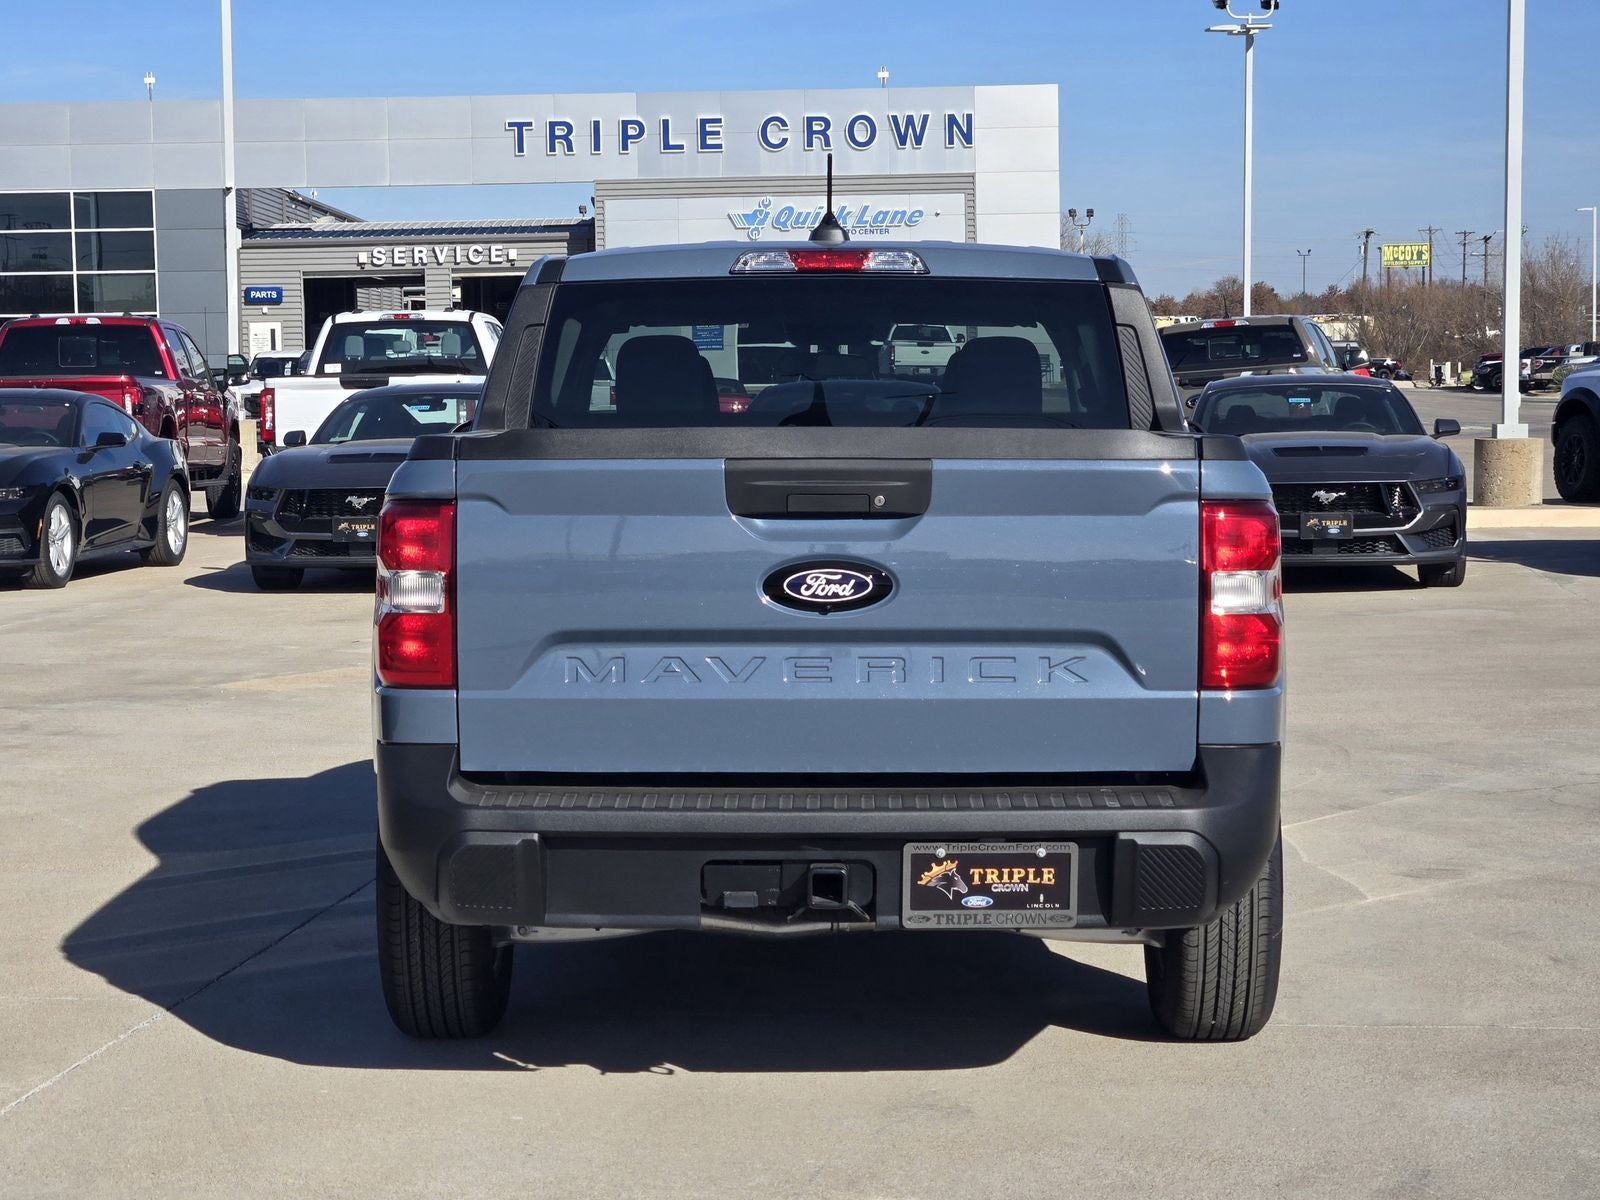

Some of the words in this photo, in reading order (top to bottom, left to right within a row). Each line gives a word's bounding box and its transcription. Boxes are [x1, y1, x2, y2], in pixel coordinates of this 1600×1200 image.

[505, 116, 724, 156] TRIPLE
[758, 112, 974, 152] CROWN
[773, 205, 852, 231] Quik
[854, 204, 925, 228] Lane
[858, 228, 890, 236] CENTER
[371, 245, 504, 266] SERVICE
[250, 290, 278, 299] PARTS
[800, 573, 856, 597] Ford
[563, 655, 1090, 684] MAVERICK
[912, 843, 1071, 852] wwwTripleCrownFordcom
[969, 867, 1056, 885] TRIPLE
[991, 884, 1029, 892] CROWN
[933, 913, 993, 925] TRIPLE
[996, 912, 1048, 925] CROWN
